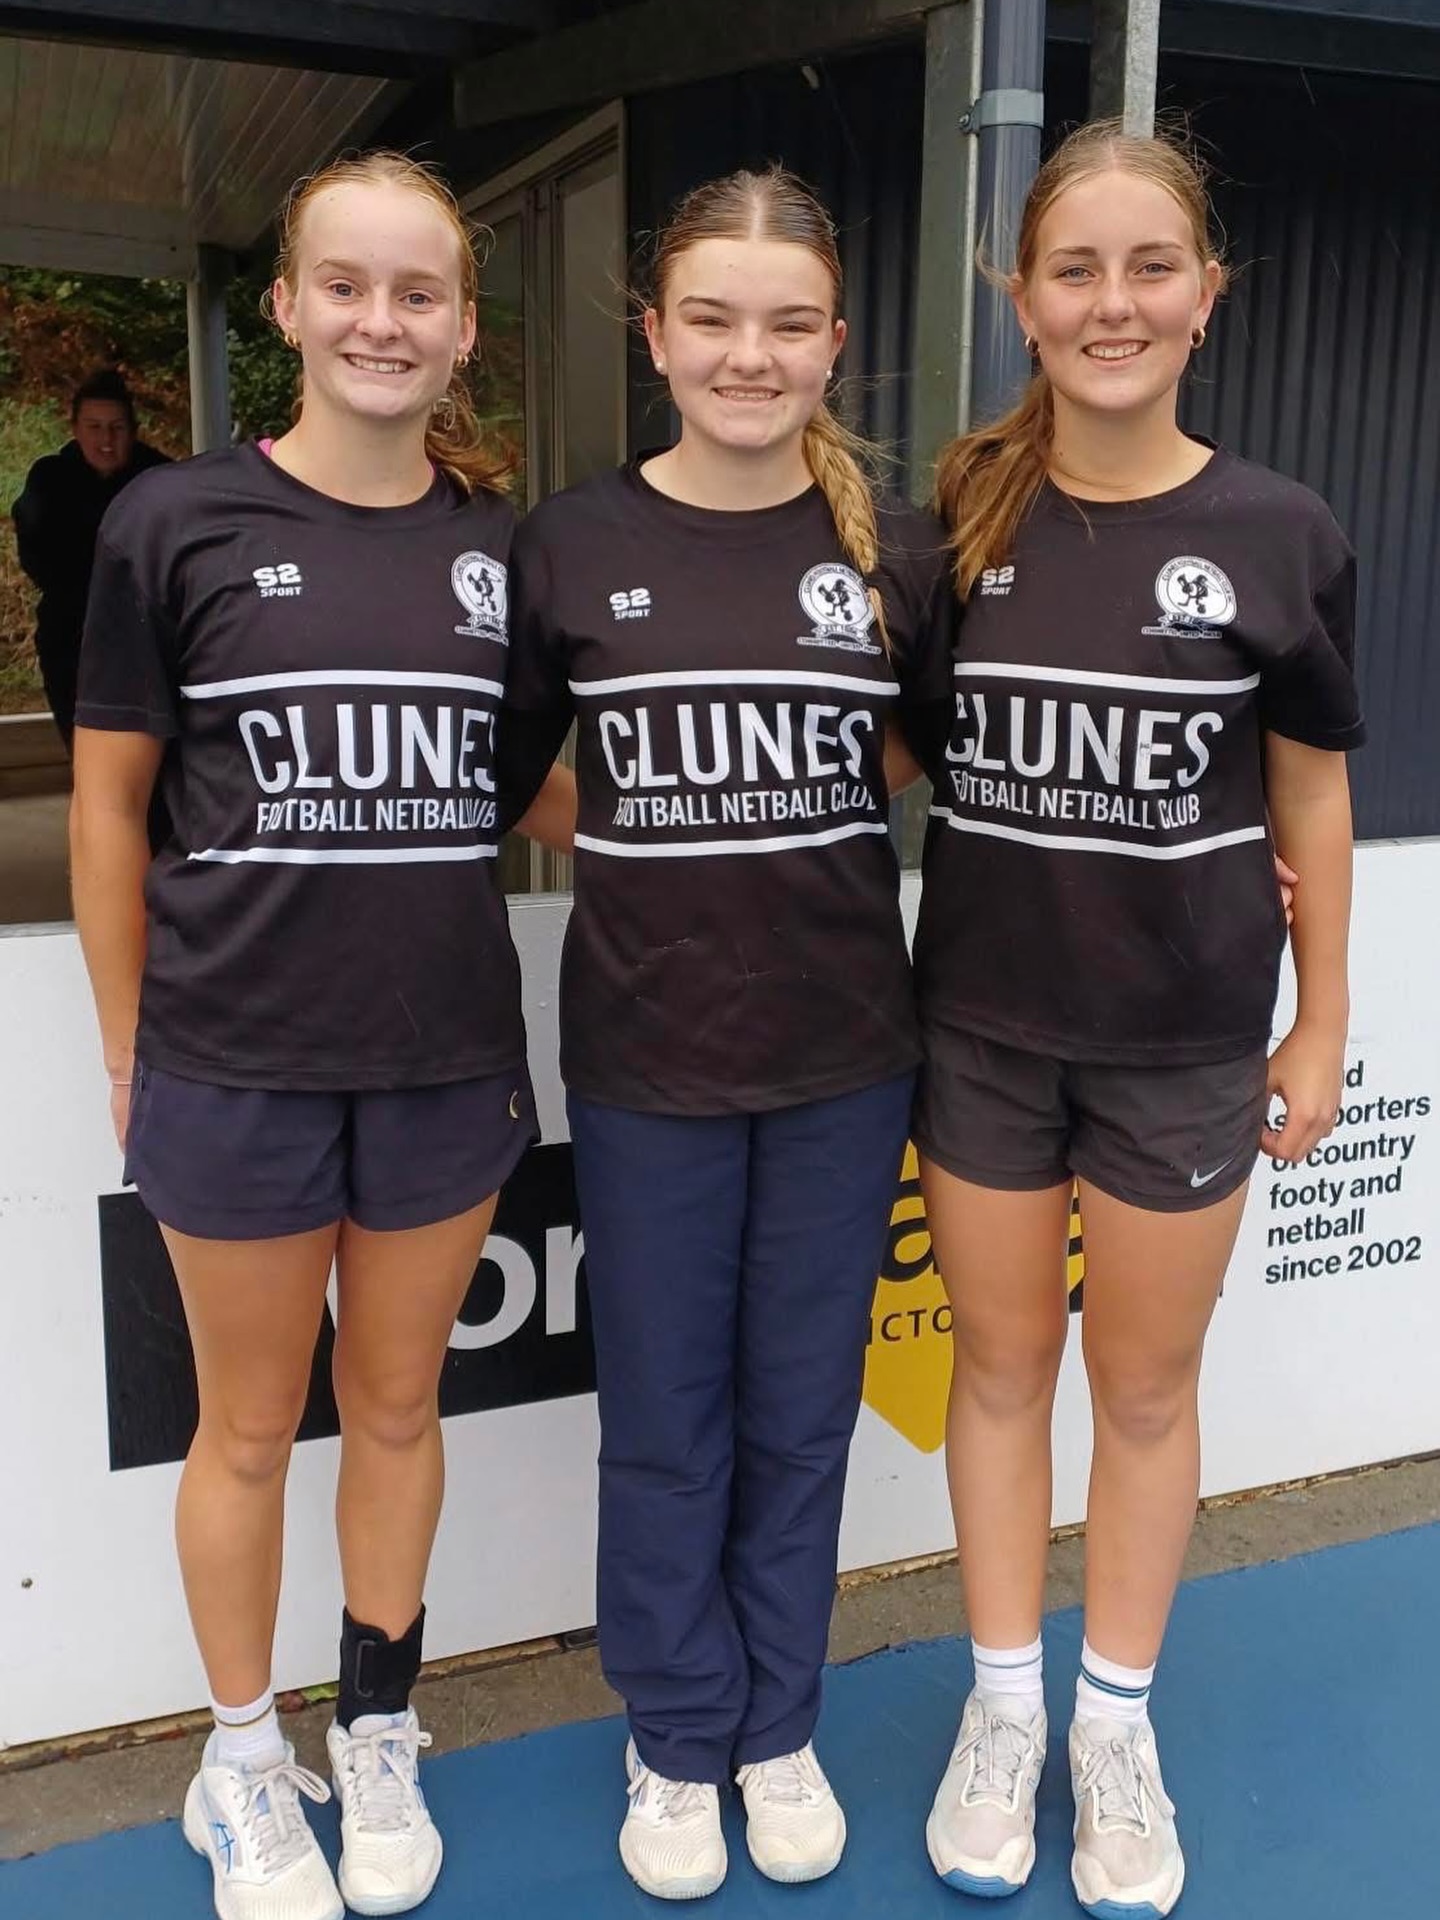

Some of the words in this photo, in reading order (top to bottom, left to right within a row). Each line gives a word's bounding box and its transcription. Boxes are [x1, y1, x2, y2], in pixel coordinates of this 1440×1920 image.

[253, 563, 302, 588] S2
[260, 586, 302, 598] SPORT
[980, 586, 1012, 596] SPORT
[982, 565, 1015, 587] S2
[609, 588, 651, 611] S2
[614, 608, 651, 620] SPORT
[599, 703, 874, 789] CLUNES
[721, 786, 827, 824] NETBALL
[1038, 787, 1155, 830] NETBALL
[1158, 793, 1201, 829] CLUB
[1306, 1133, 1416, 1168] country
[1269, 1177, 1345, 1209] footy
[1350, 1166, 1402, 1198] and
[1267, 1207, 1365, 1248] netball
[1265, 1254, 1342, 1285] since
[1347, 1235, 1422, 1272] 2002
